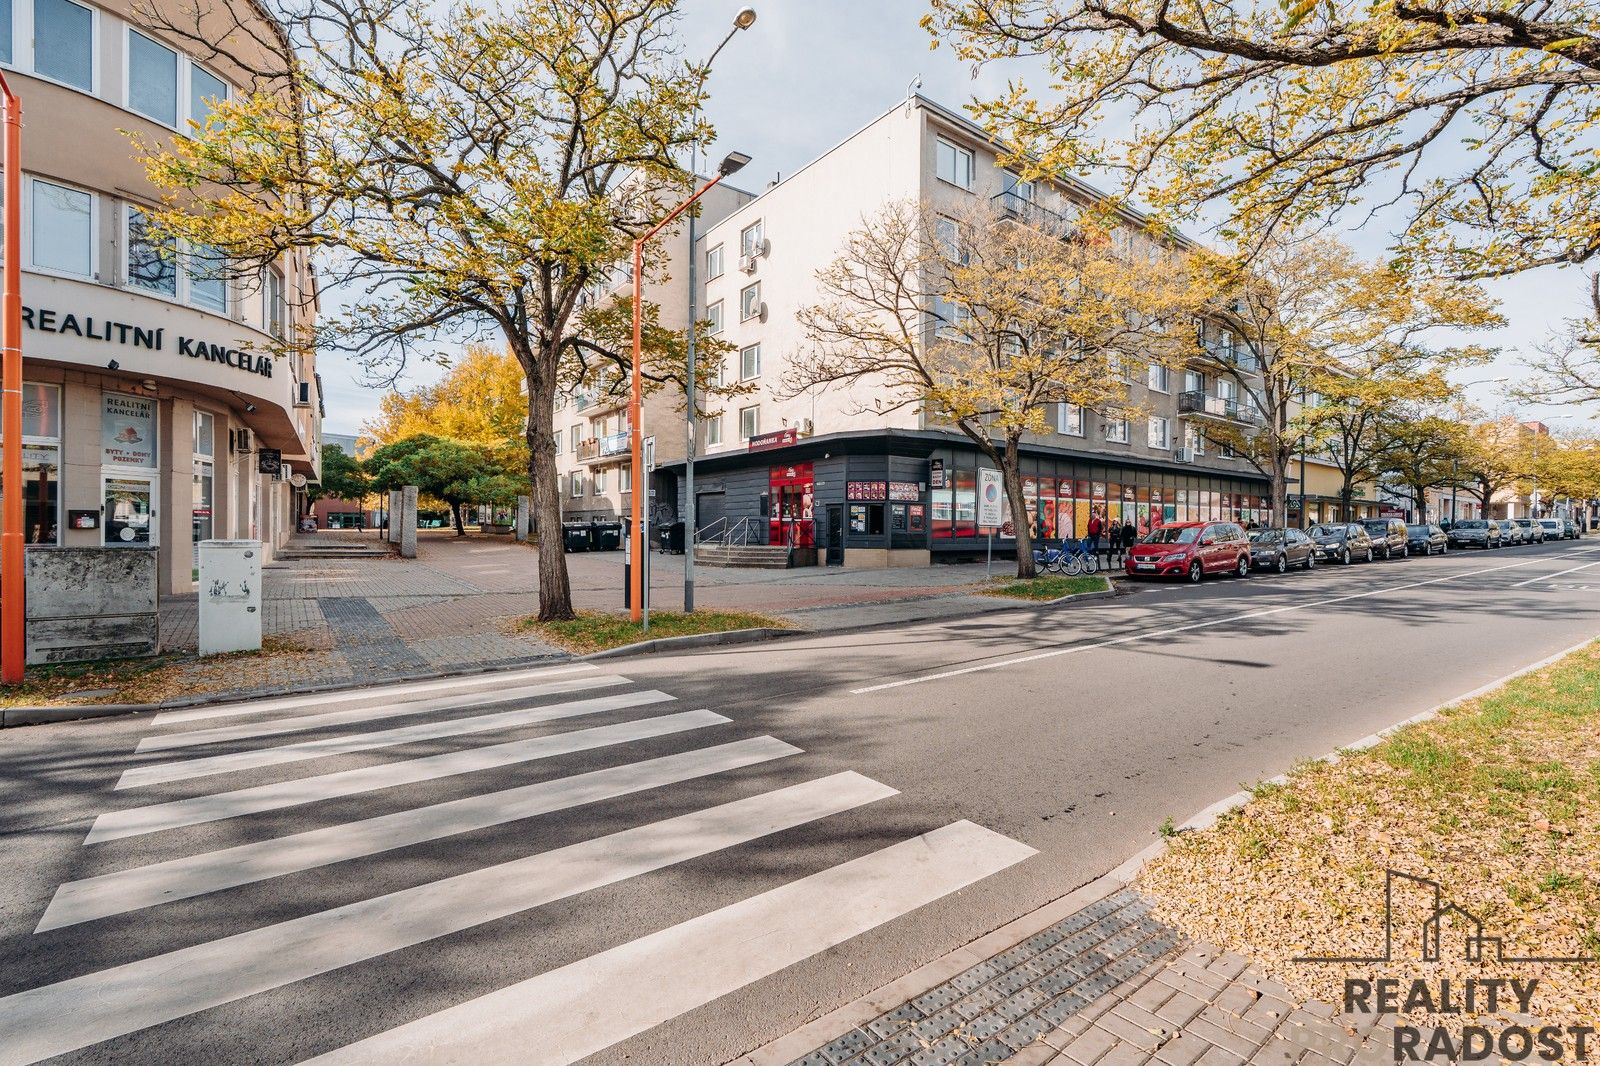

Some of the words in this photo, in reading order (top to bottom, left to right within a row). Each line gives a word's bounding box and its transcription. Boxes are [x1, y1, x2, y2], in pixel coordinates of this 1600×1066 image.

[22, 306, 165, 351] REALITNÍ
[178, 336, 273, 379] KANCELÁŘ
[107, 398, 150, 410] REALITNÍ
[113, 455, 144, 464] POZEMKY
